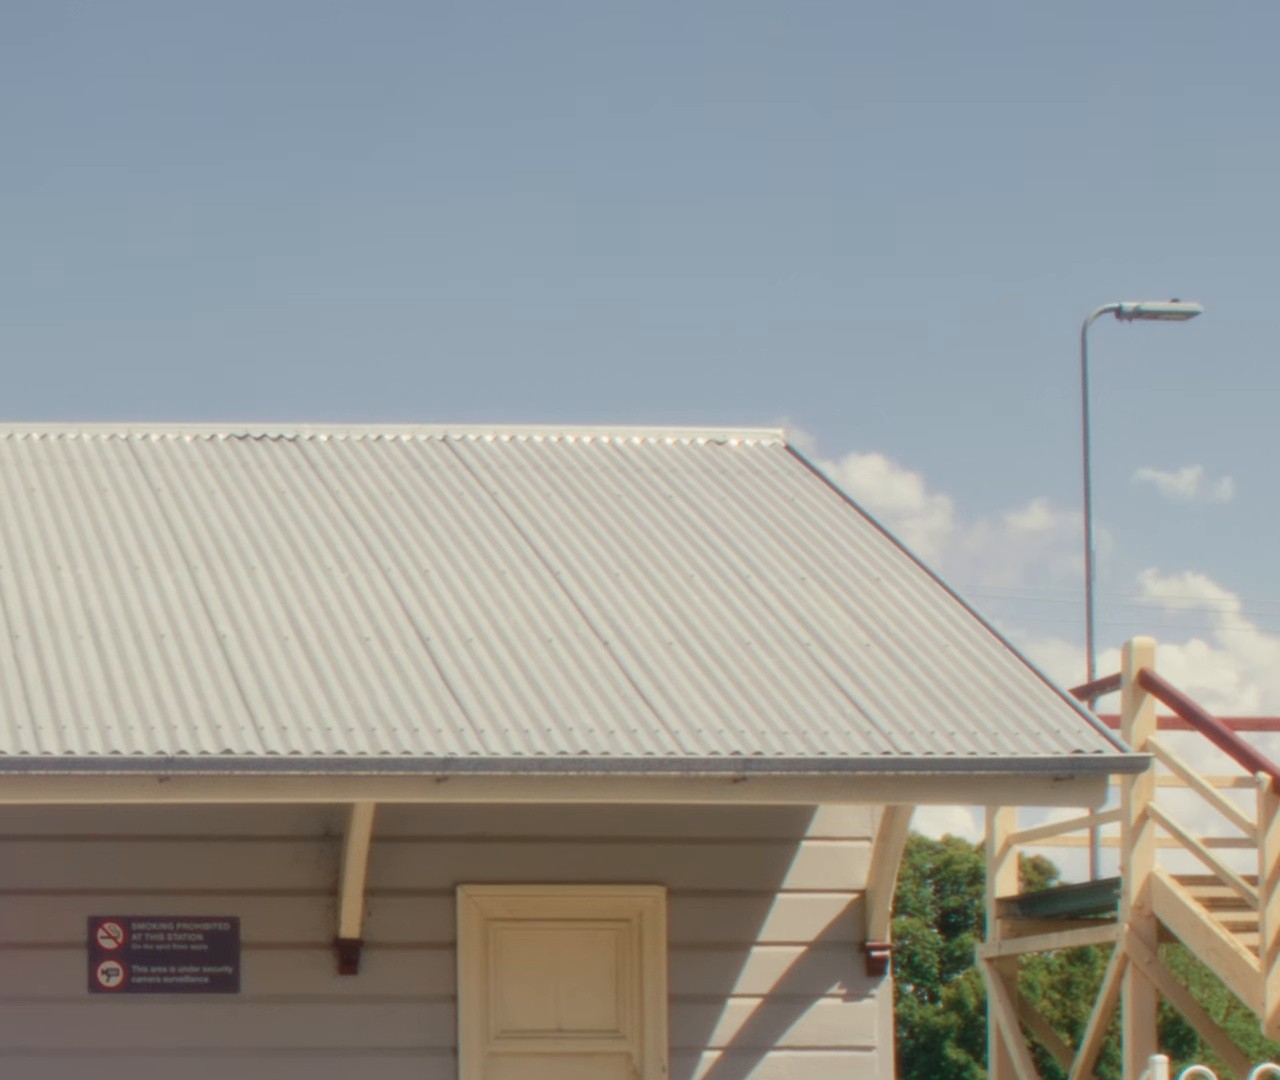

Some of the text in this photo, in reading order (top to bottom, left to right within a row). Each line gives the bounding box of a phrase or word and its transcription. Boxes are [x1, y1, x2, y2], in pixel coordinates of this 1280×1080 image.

[131, 921, 231, 931] SMOKING PROHIBITED
[131, 932, 204, 942] AT THIS STATION
[131, 964, 149, 974] This
[150, 966, 168, 974] area
[178, 964, 201, 974] under
[203, 964, 233, 975] security
[131, 976, 161, 984] camera
